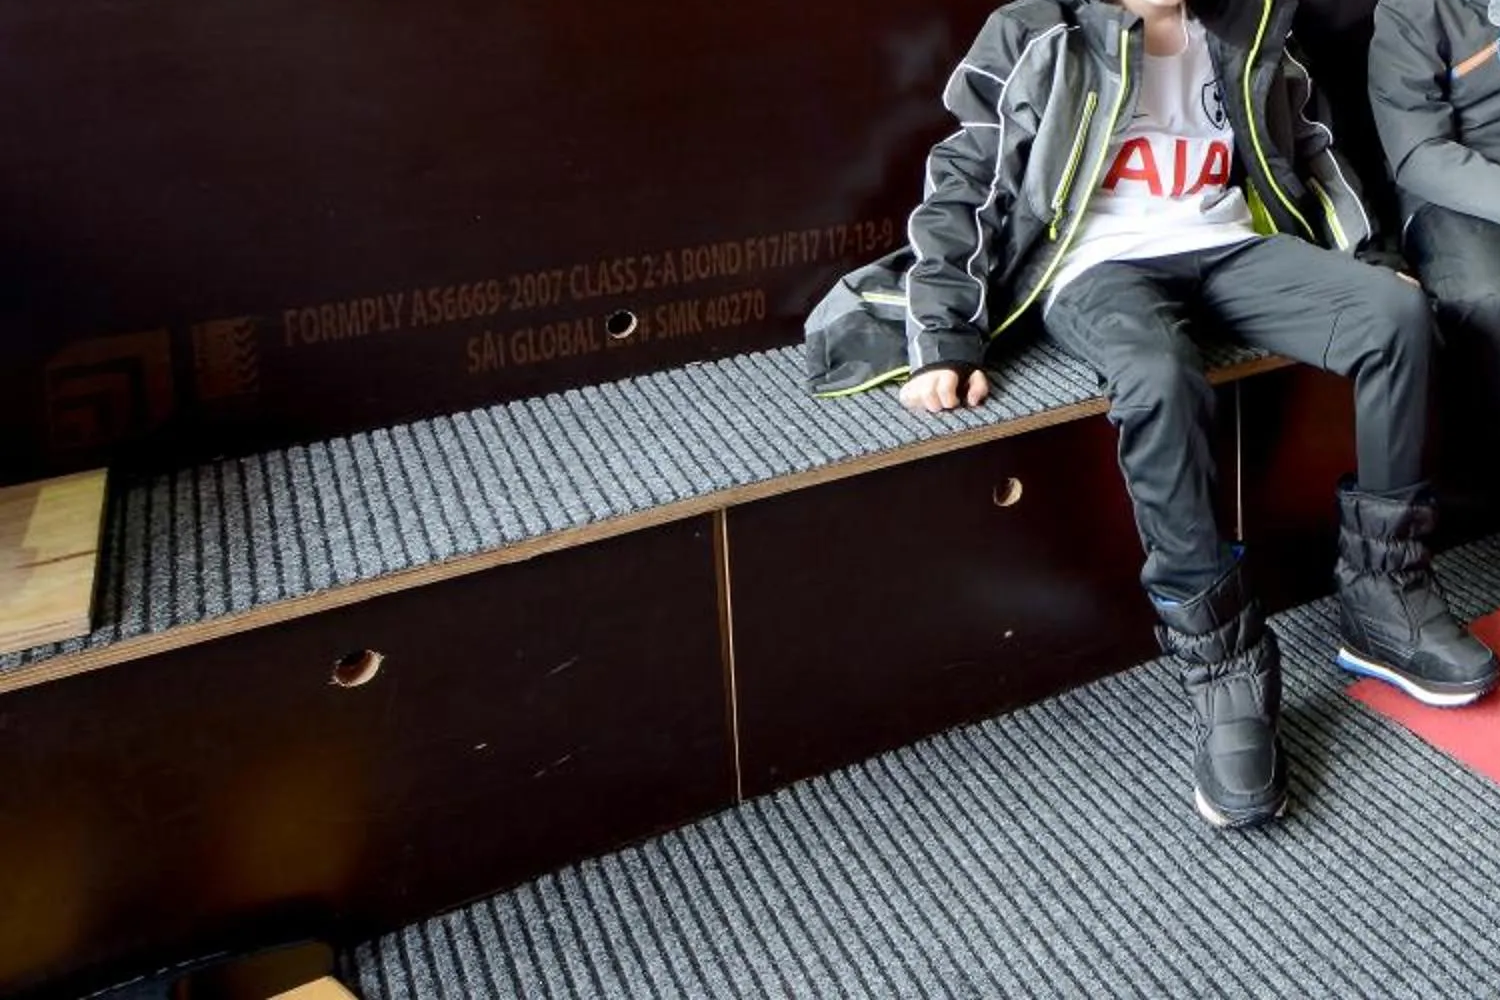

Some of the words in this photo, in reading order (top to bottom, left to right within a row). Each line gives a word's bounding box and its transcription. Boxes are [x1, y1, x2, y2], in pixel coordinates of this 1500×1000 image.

[1102, 136, 1230, 198] AIA
[283, 294, 404, 347] FORMPLY
[411, 269, 564, 327] AS6669-2007
[569, 255, 637, 299] CLASS
[642, 250, 678, 289] 2-A
[682, 240, 741, 281] BOND
[745, 228, 820, 273] F17/F17
[825, 219, 894, 258] 17-13-9
[466, 329, 505, 374] SAI
[511, 315, 599, 365] GLOBAL
[656, 299, 702, 340] SMK
[705, 288, 767, 331] 40270
